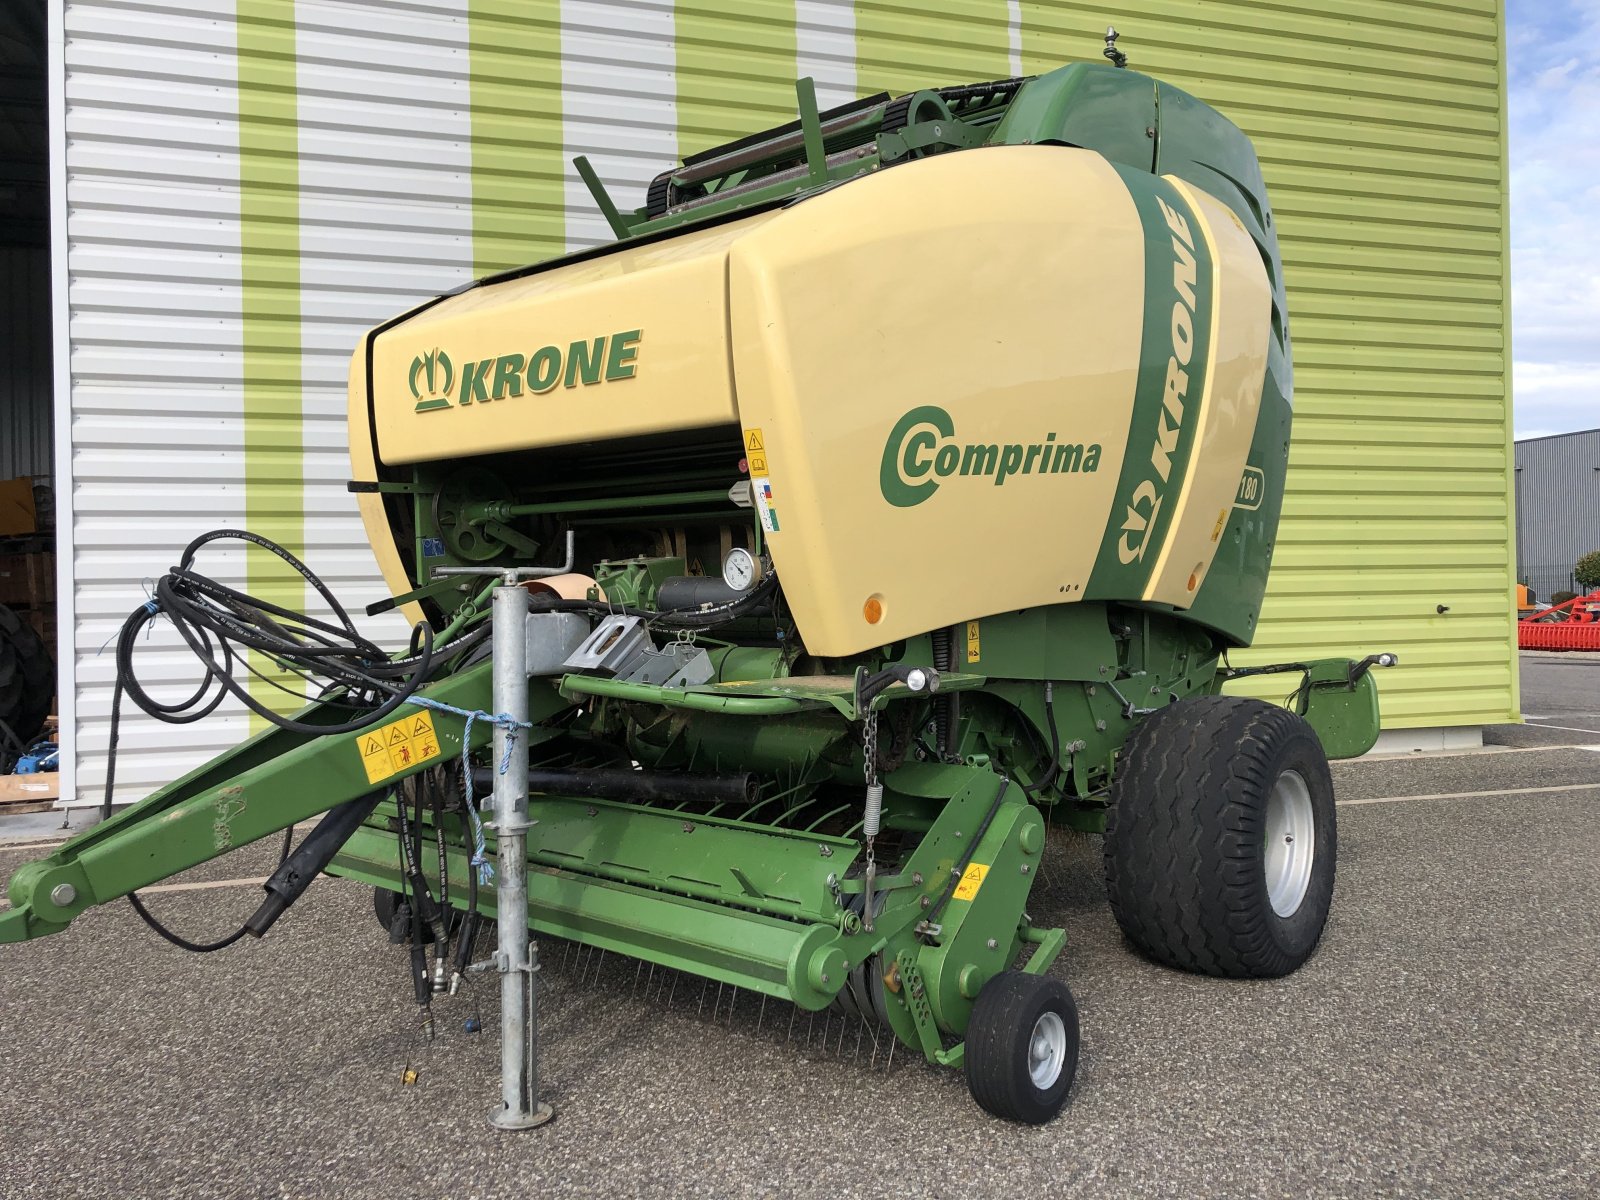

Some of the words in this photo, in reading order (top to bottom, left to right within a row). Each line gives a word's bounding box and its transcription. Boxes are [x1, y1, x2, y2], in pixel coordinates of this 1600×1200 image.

[459, 329, 642, 406] KRONE
[1150, 195, 1197, 484] KRONE
[1240, 475, 1258, 501] 180
